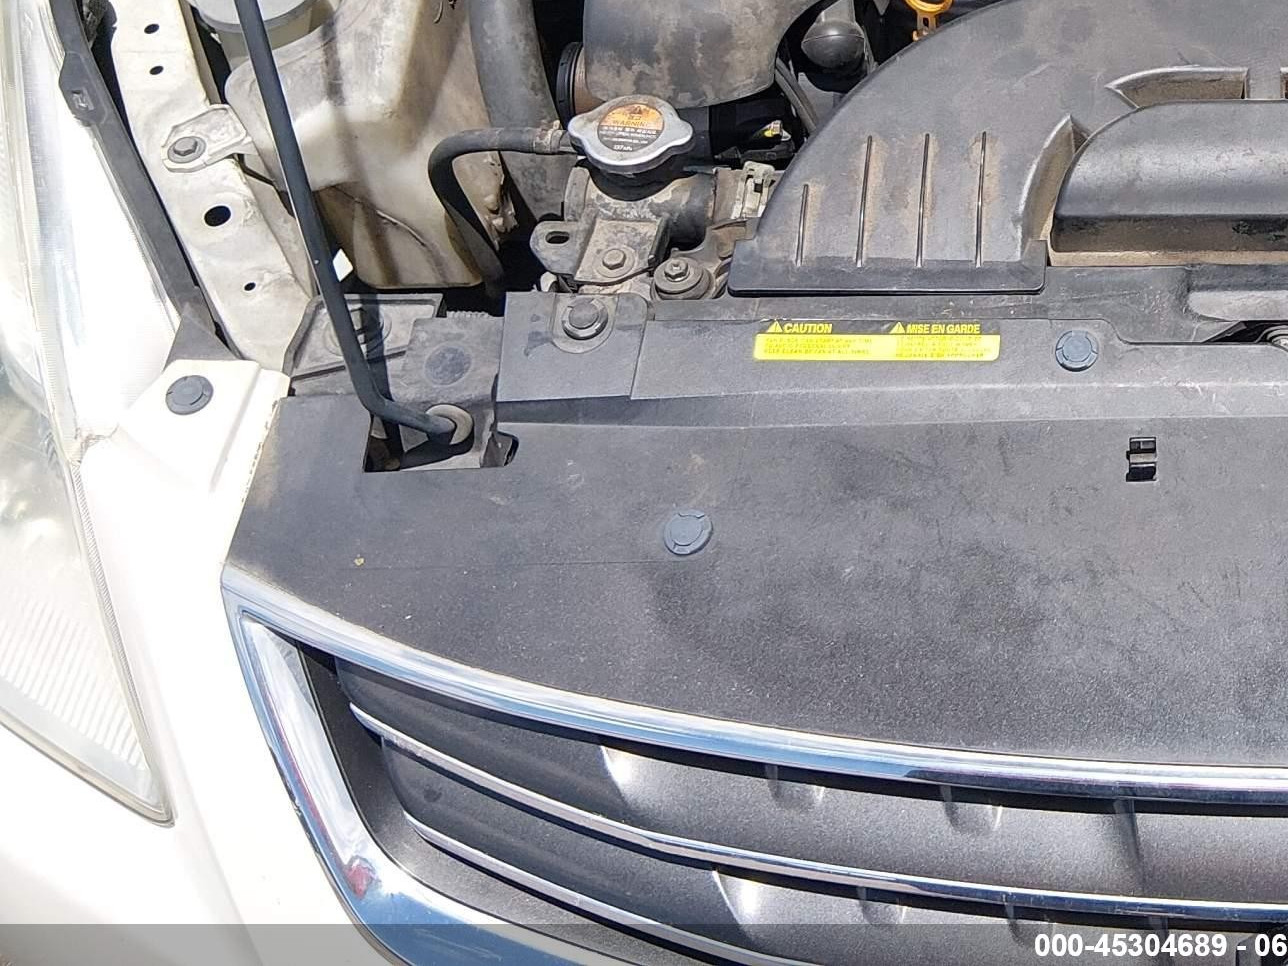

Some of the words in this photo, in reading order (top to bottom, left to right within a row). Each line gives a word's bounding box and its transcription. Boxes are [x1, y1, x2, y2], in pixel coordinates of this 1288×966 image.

[784, 322, 833, 334] CAUTION
[906, 323, 930, 334] MISE
[931, 323, 946, 334] EN
[947, 323, 981, 334] GARDE
